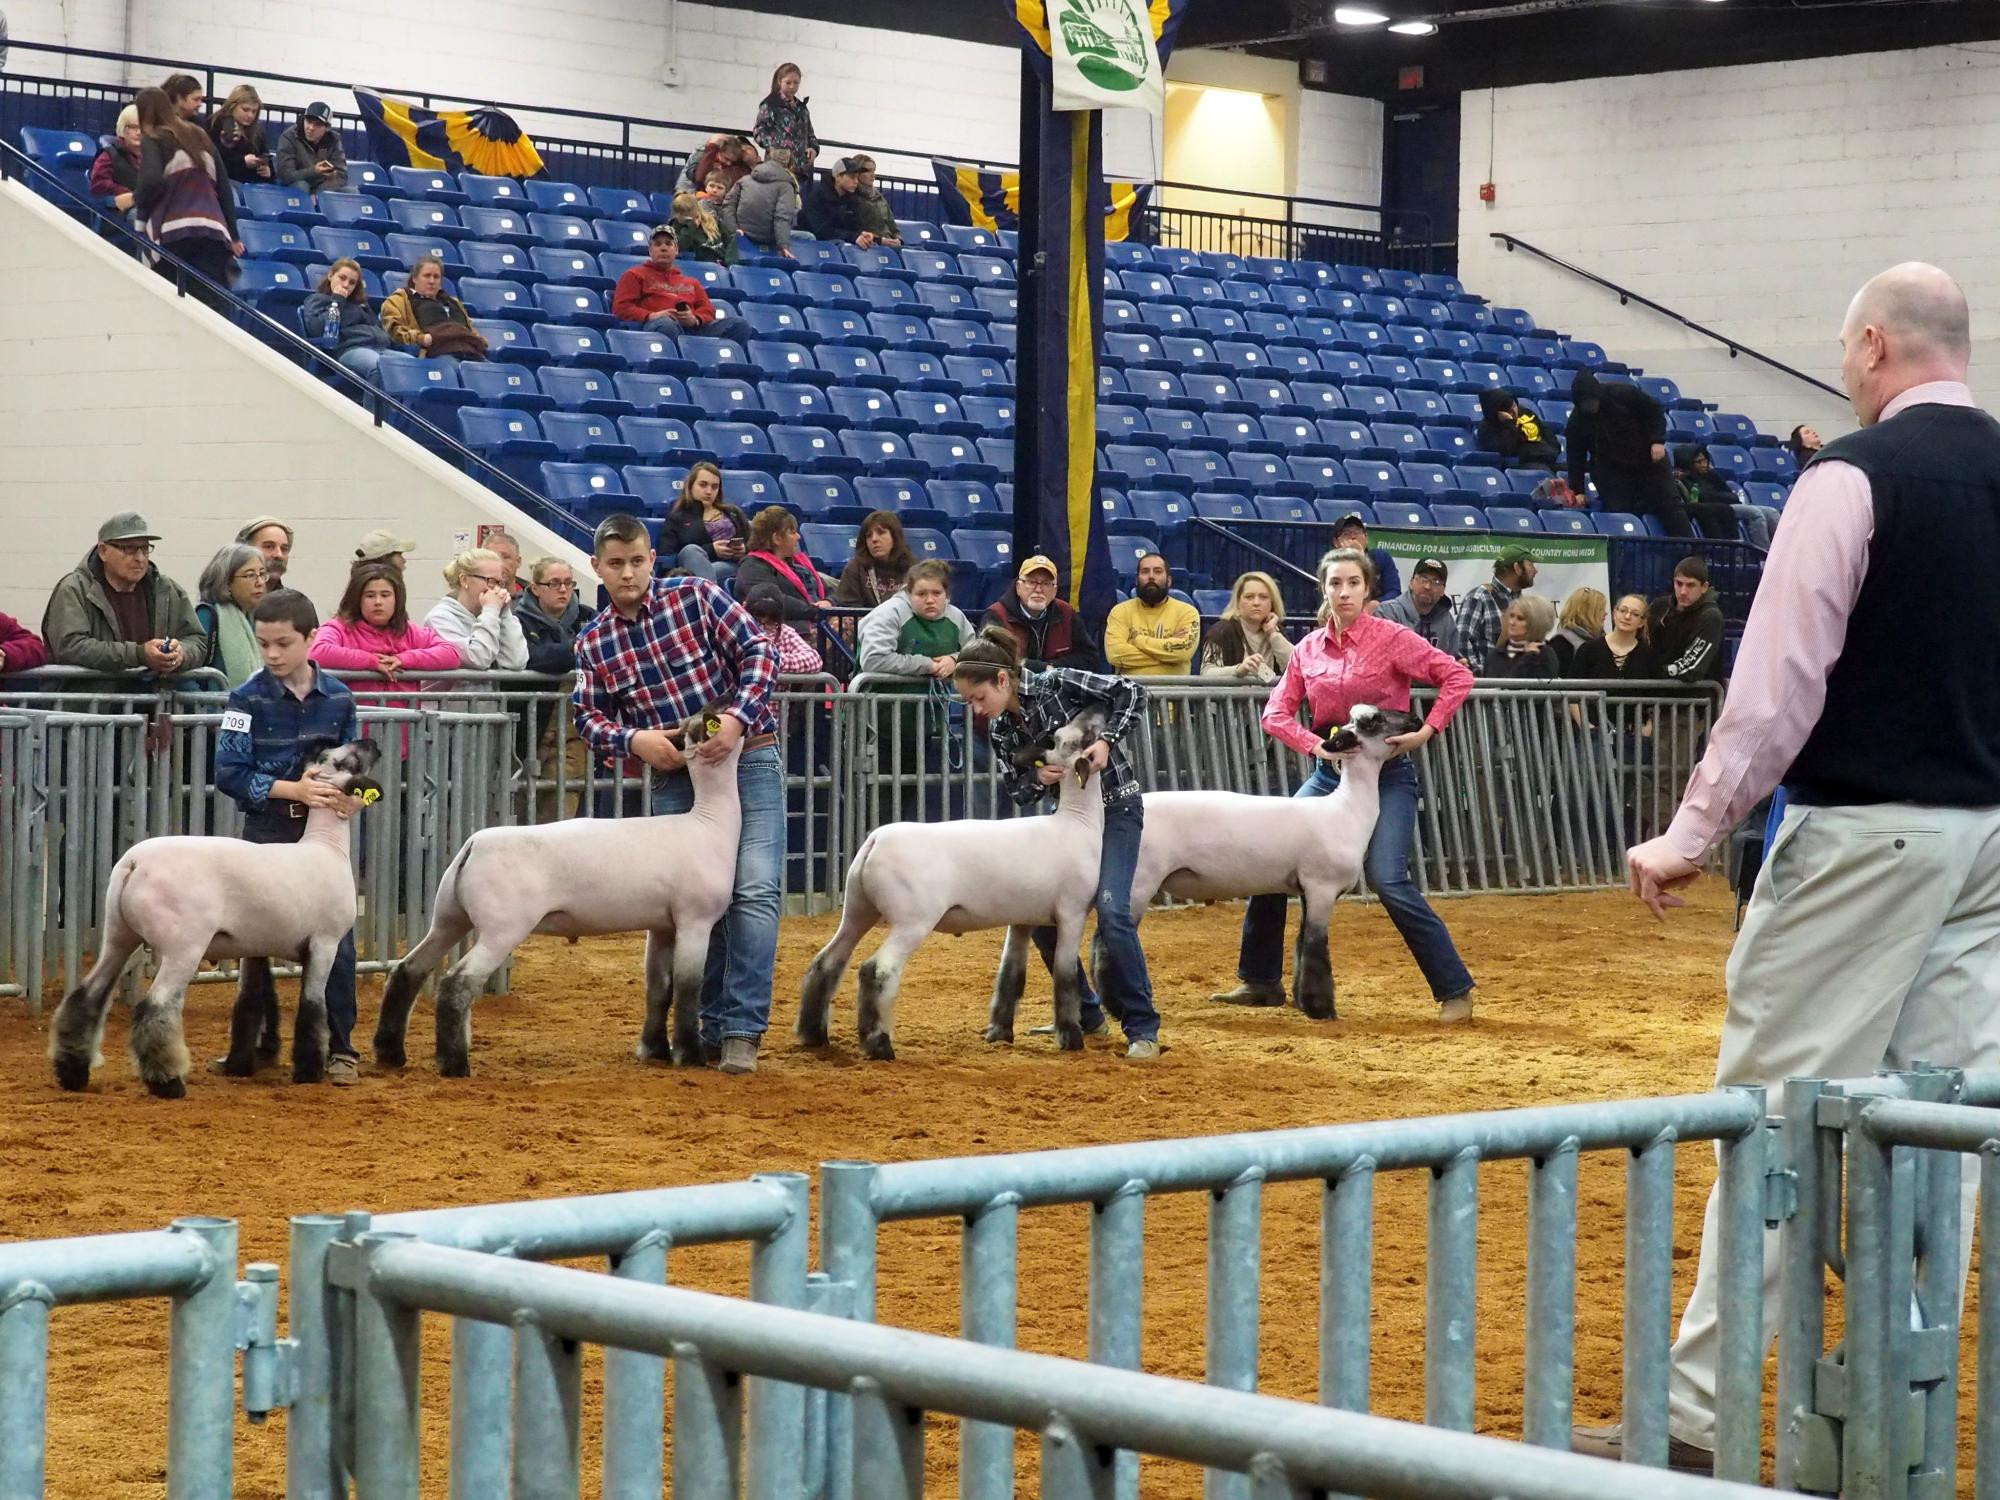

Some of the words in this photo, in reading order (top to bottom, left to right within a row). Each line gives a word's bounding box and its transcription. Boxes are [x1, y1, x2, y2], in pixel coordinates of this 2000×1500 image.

[1377, 541, 1422, 553] FINANCING
[1423, 545, 1437, 553] FOR
[1438, 545, 1450, 554] ALL
[1531, 548, 1561, 557] COUNTRY
